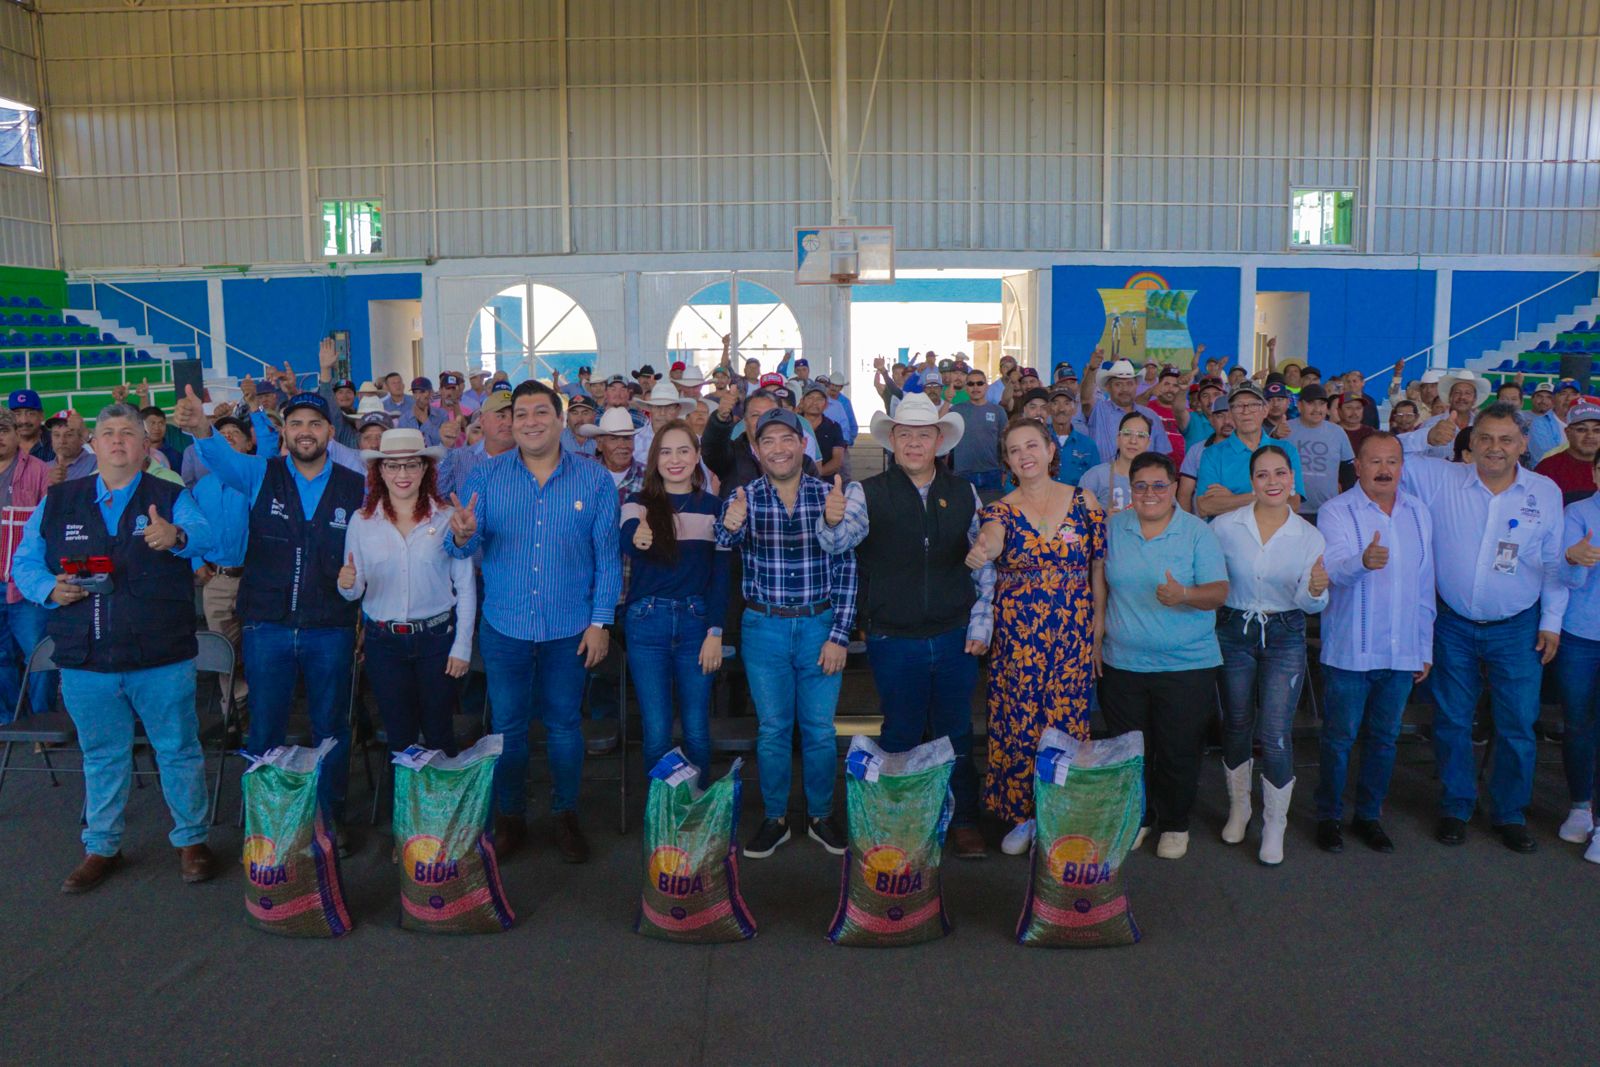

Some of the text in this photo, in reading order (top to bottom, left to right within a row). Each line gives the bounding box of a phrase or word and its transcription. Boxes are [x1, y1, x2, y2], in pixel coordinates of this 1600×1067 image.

[17, 394, 27, 403] C
[1297, 439, 1329, 455] KO
[294, 575, 300, 583] DE
[295, 566, 301, 574] LA
[94, 599, 100, 607] DE
[250, 861, 288, 885] BIDA
[414, 859, 460, 883] BIDA
[1062, 861, 1110, 885] BIDA
[659, 871, 704, 896] BIDA
[875, 870, 922, 895] BIDA
